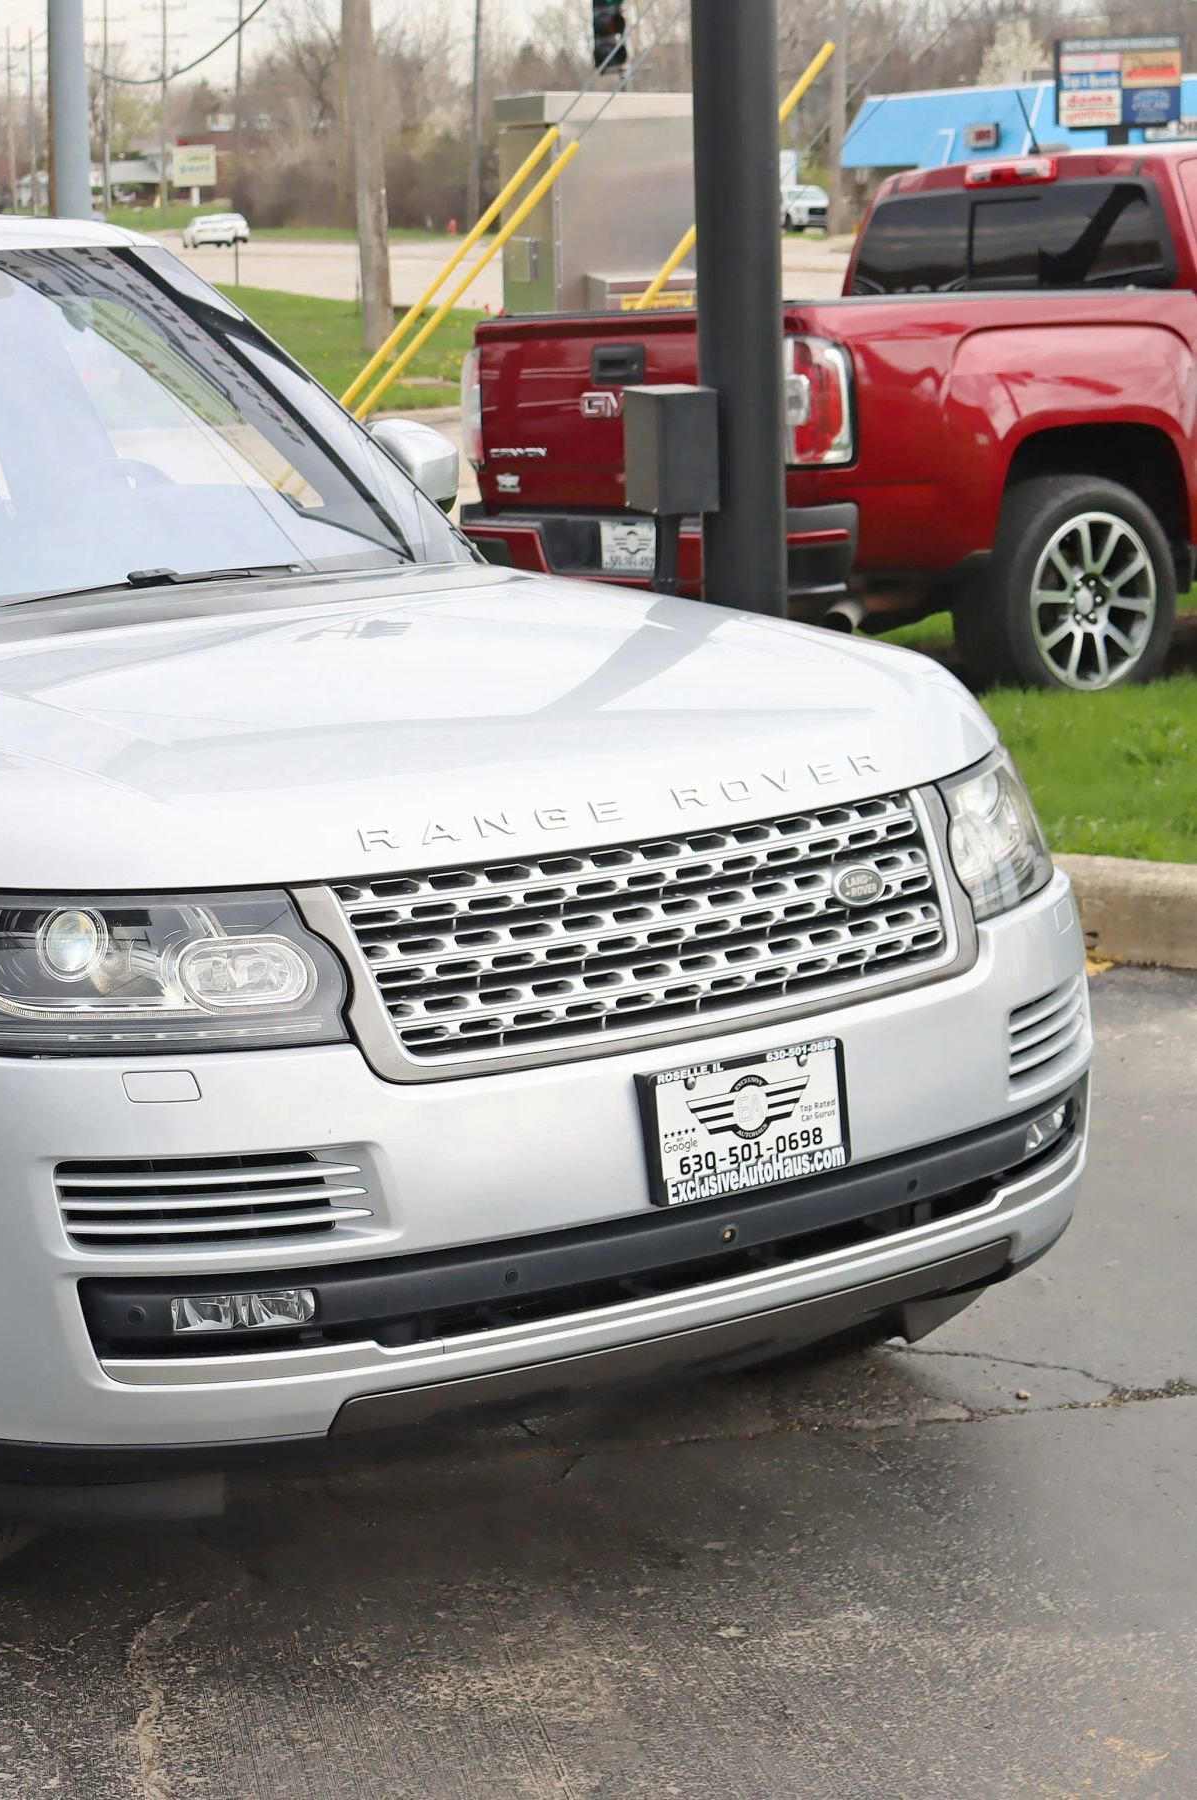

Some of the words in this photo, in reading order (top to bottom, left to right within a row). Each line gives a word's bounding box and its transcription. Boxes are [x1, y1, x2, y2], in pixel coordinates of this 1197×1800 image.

[357, 801, 624, 852] RANGE
[670, 756, 882, 810] ROVER
[845, 874, 869, 888] LAND
[850, 883, 878, 897] ROVER
[712, 1062, 724, 1073] IL
[765, 1039, 837, 1062] 630-501-0698
[800, 1103, 812, 1113] Top
[814, 1098, 836, 1111] Rated
[801, 1113, 813, 1122] Car
[814, 1108, 836, 1119] Gurus
[663, 1137, 699, 1154] Google
[679, 1127, 823, 1176] 630-501-0698
[666, 1146, 846, 1206] ExclusiveAutoHaus.com
